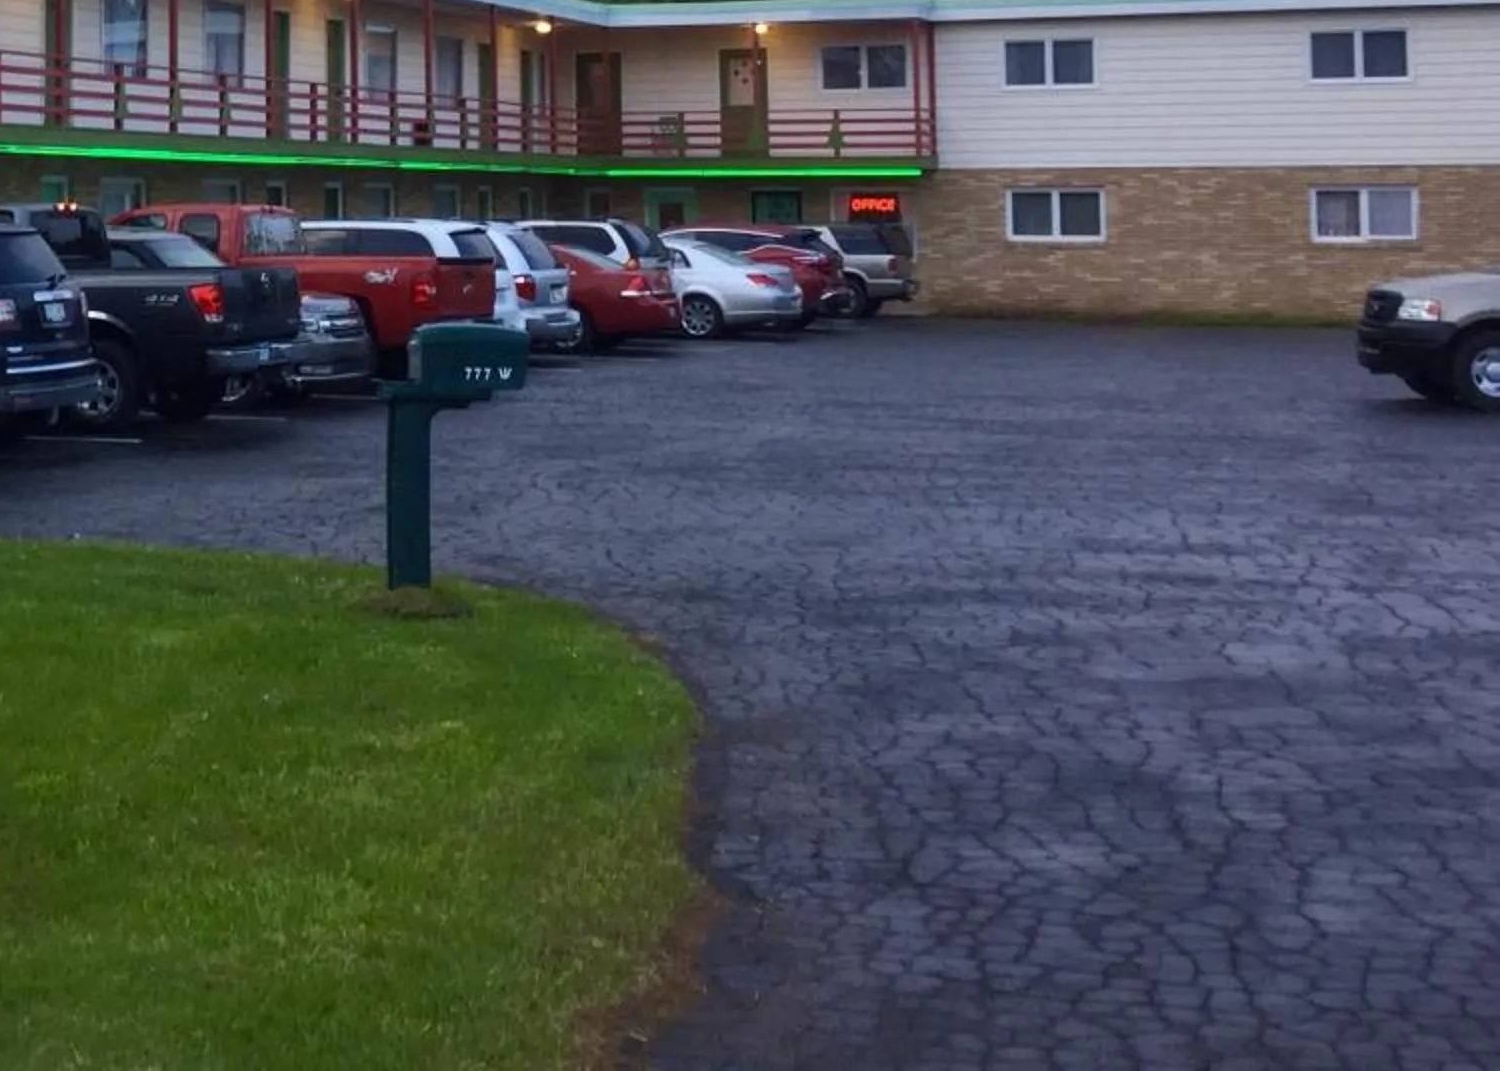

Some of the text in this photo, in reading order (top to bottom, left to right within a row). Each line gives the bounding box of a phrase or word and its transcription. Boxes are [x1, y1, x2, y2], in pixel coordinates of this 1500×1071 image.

[851, 197, 895, 211] OFFICE
[464, 366, 512, 381] 777 W
